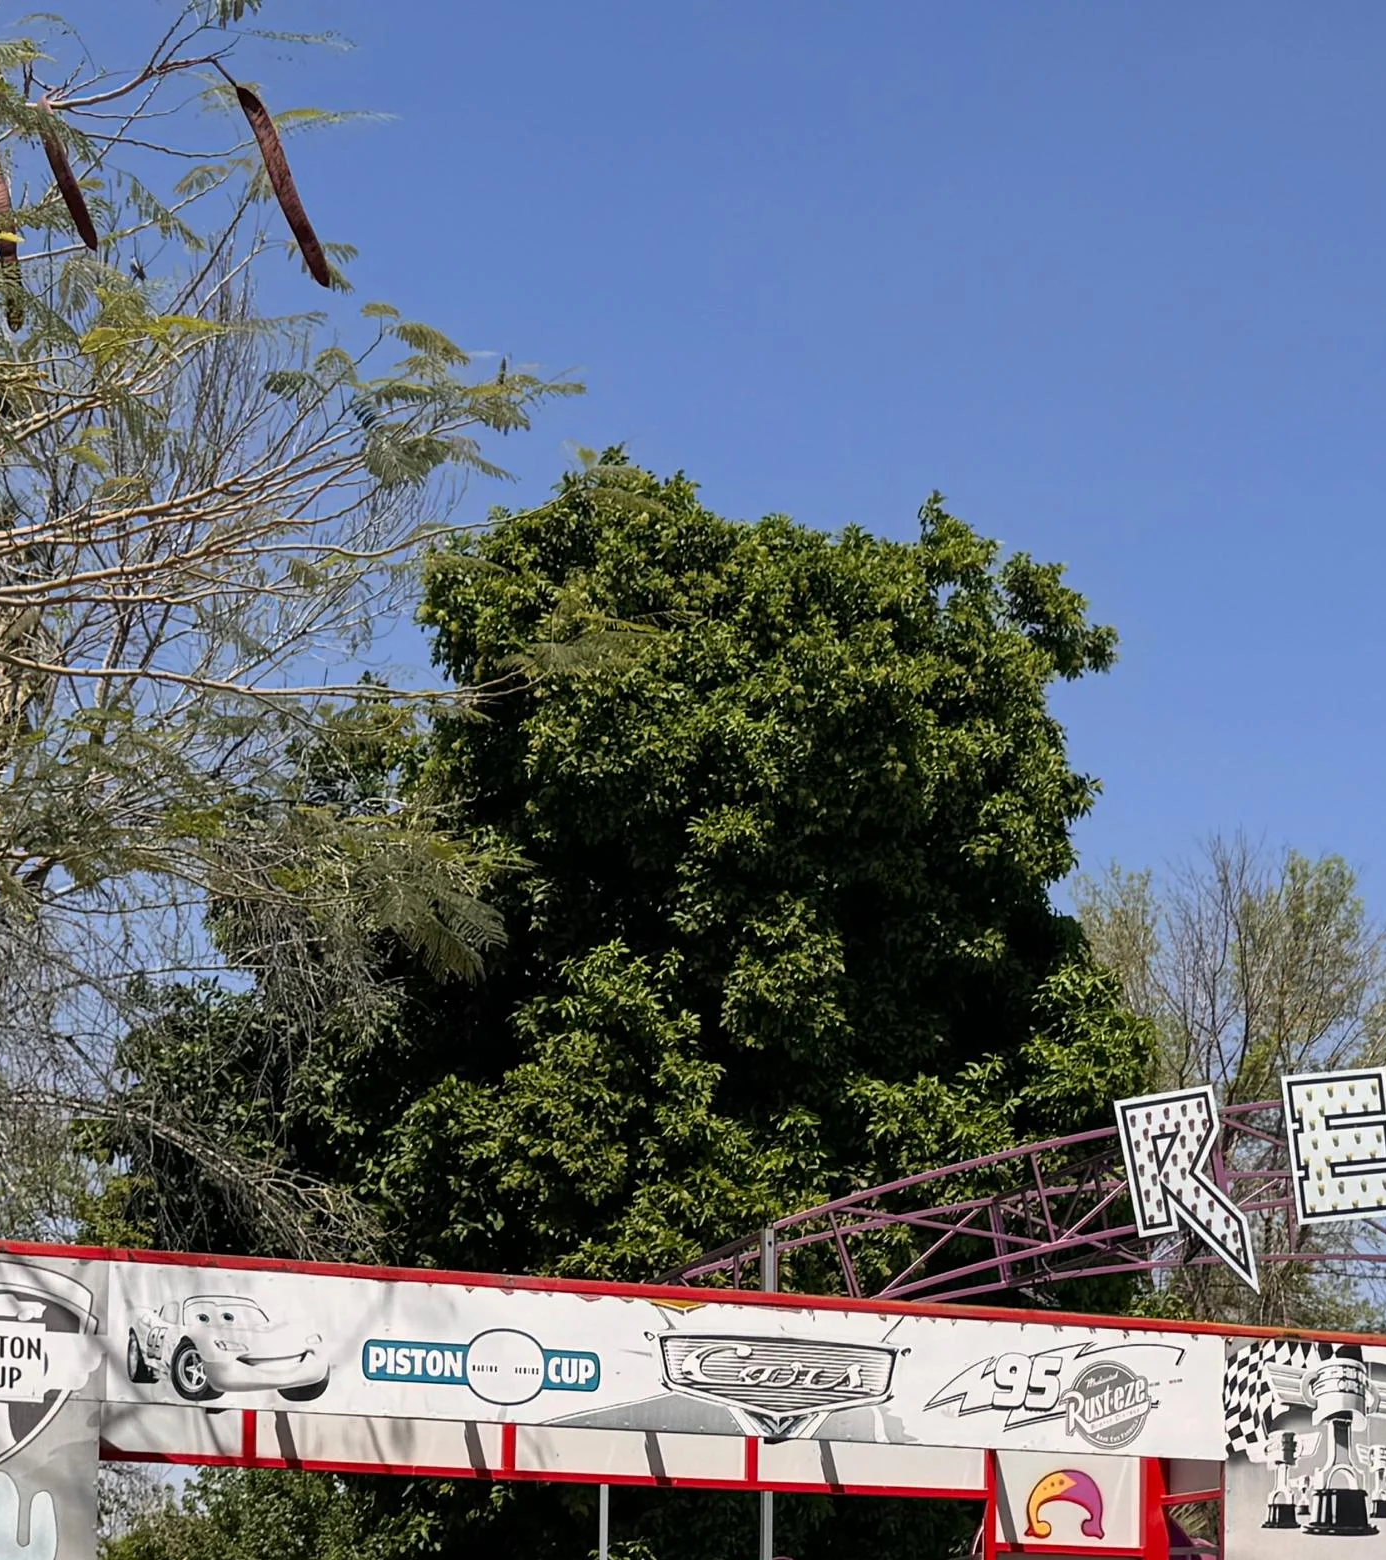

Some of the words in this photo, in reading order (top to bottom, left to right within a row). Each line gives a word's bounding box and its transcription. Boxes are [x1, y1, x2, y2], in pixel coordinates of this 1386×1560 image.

[368, 1346, 463, 1378] PISTON
[547, 1357, 596, 1386] CUP
[992, 1352, 1065, 1412] 95
